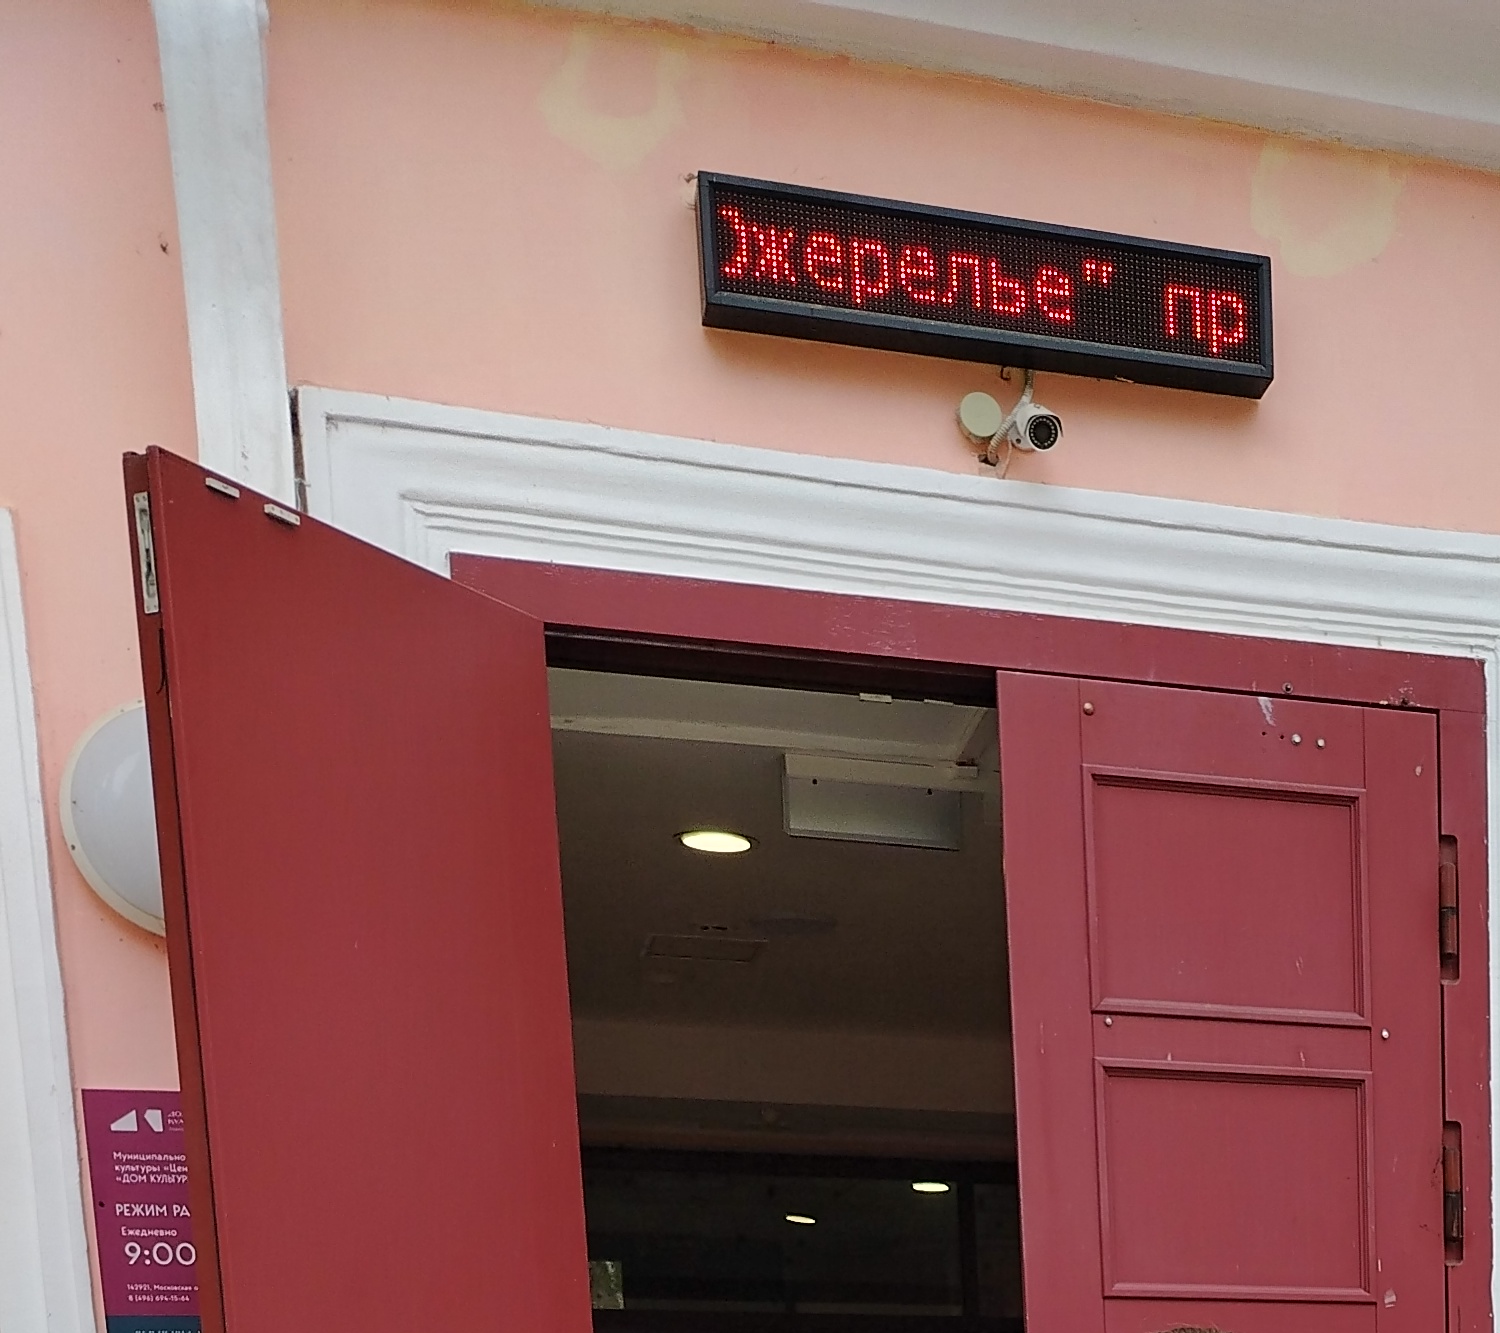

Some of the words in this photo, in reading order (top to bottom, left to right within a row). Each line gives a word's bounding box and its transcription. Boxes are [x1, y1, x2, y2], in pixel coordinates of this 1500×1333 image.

[1164, 281, 1246, 355] пр
[114, 1164, 160, 1174] культуры
[116, 1173, 147, 1184] «ДОМ
[115, 1203, 168, 1217] РЕЖИМ
[172, 1204, 191, 1217] РА
[121, 1226, 178, 1237] Ежедневно
[124, 1241, 196, 1266] 9:00
